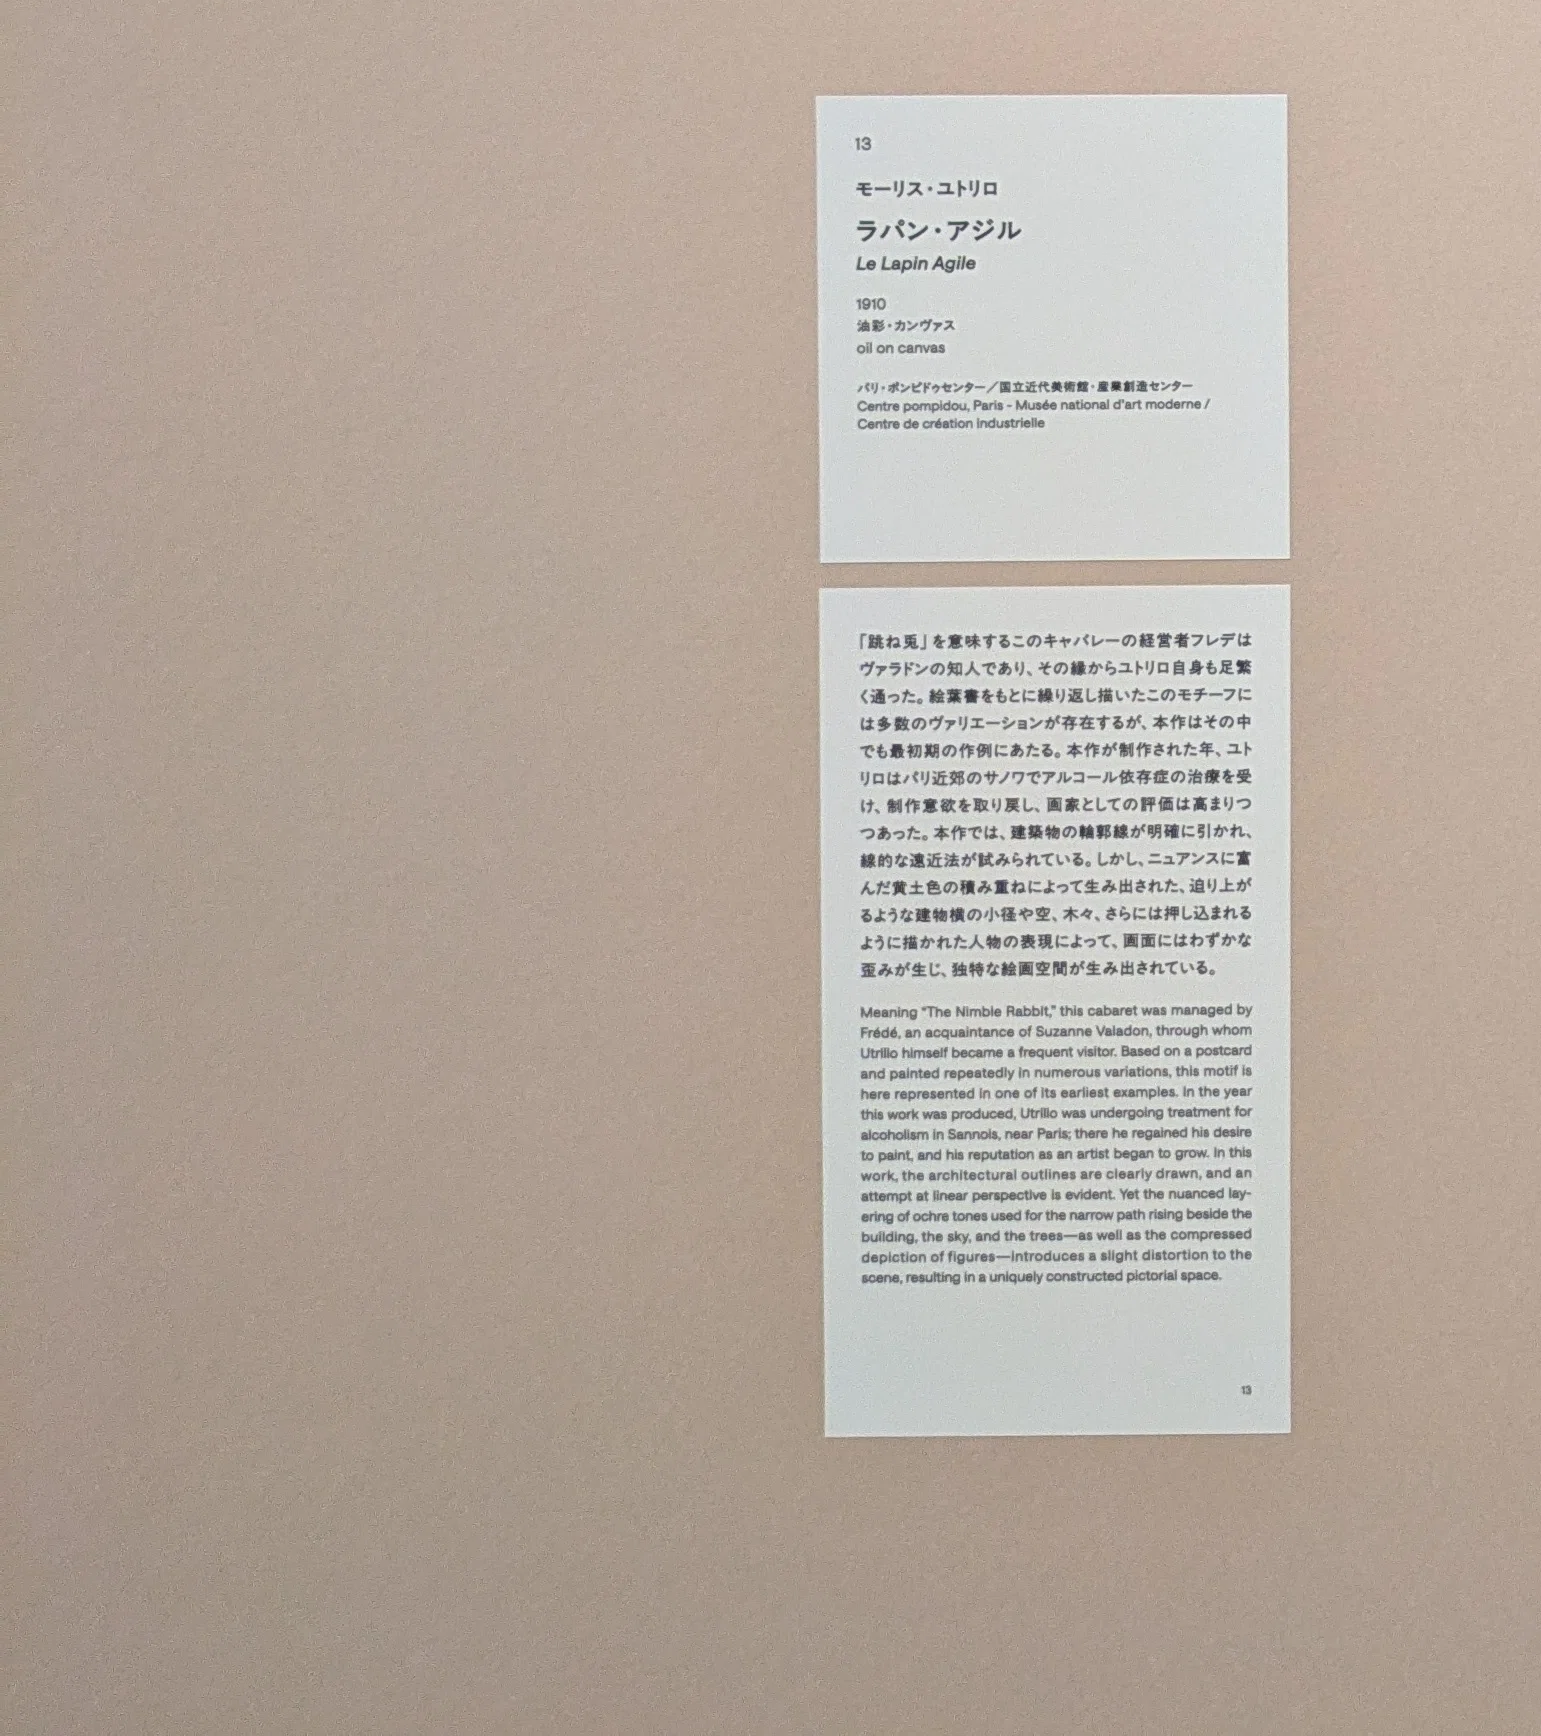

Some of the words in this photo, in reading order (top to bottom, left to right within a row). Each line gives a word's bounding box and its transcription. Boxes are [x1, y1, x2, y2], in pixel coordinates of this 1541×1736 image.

[855, 136, 872, 151] 13
[856, 180, 997, 198] モーリス・ユトリロ
[856, 218, 1022, 242] ラパン・アジル
[856, 256, 877, 271] Le
[881, 255, 929, 274] Lapin
[931, 255, 976, 274] Agile
[856, 298, 886, 311] 1910
[857, 319, 955, 332] 油彩・カンヴァス
[856, 342, 873, 355] oil
[876, 345, 894, 355] on
[897, 343, 945, 354] canvas
[857, 400, 900, 412] Centre
[903, 400, 970, 413] pompidou,
[973, 399, 1004, 411] Paris
[1015, 399, 1057, 411] Musée
[1060, 399, 1110, 411] national
[1113, 399, 1142, 410] d'art
[1145, 398, 1201, 409] moderne
[857, 418, 900, 430] Centre
[903, 419, 919, 430] de
[922, 418, 973, 430] création
[976, 417, 1045, 428] industrielle
[860, 1006, 918, 1022] Meaning
[955, 1005, 1002, 1018] Nimble
[1059, 1005, 1084, 1017] this
[1087, 1004, 1138, 1017] cabaret
[1140, 1006, 1167, 1017] was
[1170, 1003, 1233, 1019] managed
[1236, 1003, 1253, 1019] by
[860, 1026, 902, 1040] Frédé,
[904, 1029, 922, 1039] an
[924, 1026, 1015, 1041] acquaintance
[1018, 1025, 1033, 1039] of
[1035, 1024, 1093, 1038] Suzanne
[1095, 1024, 1153, 1039] Valadon,
[1155, 1024, 1209, 1039] through
[1211, 1024, 1252, 1037] whom
[860, 1046, 899, 1060] Utrillo
[901, 1046, 949, 1059] himself
[951, 1046, 1004, 1059] became
[1007, 1048, 1016, 1059] a
[1018, 1045, 1074, 1061] frequent
[1076, 1046, 1118, 1058] visitor.
[1120, 1045, 1161, 1058] Based
[1163, 1046, 1181, 1057] on
[1183, 1046, 1192, 1057] a
[1195, 1044, 1252, 1059] postcard
[860, 1088, 891, 1101] here
[894, 1087, 975, 1103] represented
[978, 1087, 991, 1100] in
[994, 1089, 1020, 1100] one
[1023, 1086, 1038, 1101] of
[1040, 1087, 1057, 1100] its
[1060, 1085, 1110, 1099] earliest
[1112, 1085, 1179, 1101] examples.
[1182, 1085, 1195, 1098] In
[1198, 1085, 1220, 1099] the
[1223, 1087, 1253, 1100] year
[860, 1109, 884, 1122] this
[887, 1107, 920, 1121] work
[922, 1110, 948, 1120] was
[950, 1107, 1017, 1123] produced,
[1019, 1107, 1058, 1121] Utrillo
[1061, 1109, 1087, 1120] was
[1089, 1106, 1164, 1122] undergoing
[1167, 1105, 1231, 1119] treatment
[1234, 1104, 1253, 1118] for
[859, 1150, 875, 1162] to
[877, 1149, 914, 1164] paint,
[917, 1148, 942, 1162] and
[945, 1148, 964, 1161] his
[967, 1148, 1035, 1164] reputation
[1038, 1150, 1053, 1161] as
[1056, 1150, 1073, 1161] an
[1076, 1147, 1110, 1160] artist
[1113, 1147, 1155, 1162] began
[1157, 1147, 1172, 1160] to
[1174, 1149, 1210, 1162] grow.
[1213, 1146, 1226, 1160] In
[1228, 1146, 1252, 1159] this
[860, 1190, 913, 1205] attempt
[915, 1190, 929, 1204] at
[932, 1189, 969, 1203] linear
[971, 1188, 1047, 1204] perspective
[1050, 1188, 1062, 1201] is
[1064, 1188, 1116, 1201] evident.
[1119, 1188, 1140, 1201] Yet
[1142, 1188, 1165, 1201] the
[1168, 1187, 1225, 1200] nuanced
[1228, 1187, 1252, 1202] lay-
[860, 1210, 895, 1225] ering
[896, 1209, 911, 1223] of
[912, 1210, 950, 1223] ochre
[951, 1211, 988, 1223] tones
[990, 1209, 1022, 1223] used
[1024, 1209, 1043, 1222] for
[1045, 1210, 1067, 1222] the
[1069, 1210, 1114, 1221] narrow
[1116, 1208, 1146, 1223] path
[1148, 1208, 1183, 1223] rising
[1186, 1207, 1229, 1220] beside
[1230, 1208, 1253, 1220] the
[861, 1231, 919, 1247] building,
[920, 1230, 944, 1243] the
[946, 1230, 972, 1246] sky,
[975, 1229, 1001, 1243] and
[1003, 1229, 1026, 1243] the
[1096, 1229, 1123, 1242] well
[1126, 1231, 1142, 1242] as
[1144, 1229, 1167, 1242] the
[1170, 1227, 1252, 1243] compressed
[861, 1251, 927, 1266] depiction
[930, 1250, 945, 1264] of
[1088, 1252, 1097, 1262] a
[1100, 1249, 1138, 1264] slight
[1141, 1248, 1209, 1262] distortion
[1211, 1249, 1226, 1261] to
[1229, 1248, 1252, 1261] the
[861, 1273, 903, 1285] scene,
[905, 1271, 961, 1286] resulting
[963, 1270, 976, 1283] in
[978, 1273, 987, 1284] a
[989, 1270, 1044, 1286] uniquely
[1045, 1270, 1123, 1283] constructed
[1126, 1269, 1178, 1284] pictorial
[1180, 1271, 1222, 1284] space.
[1241, 1385, 1252, 1395] 13
